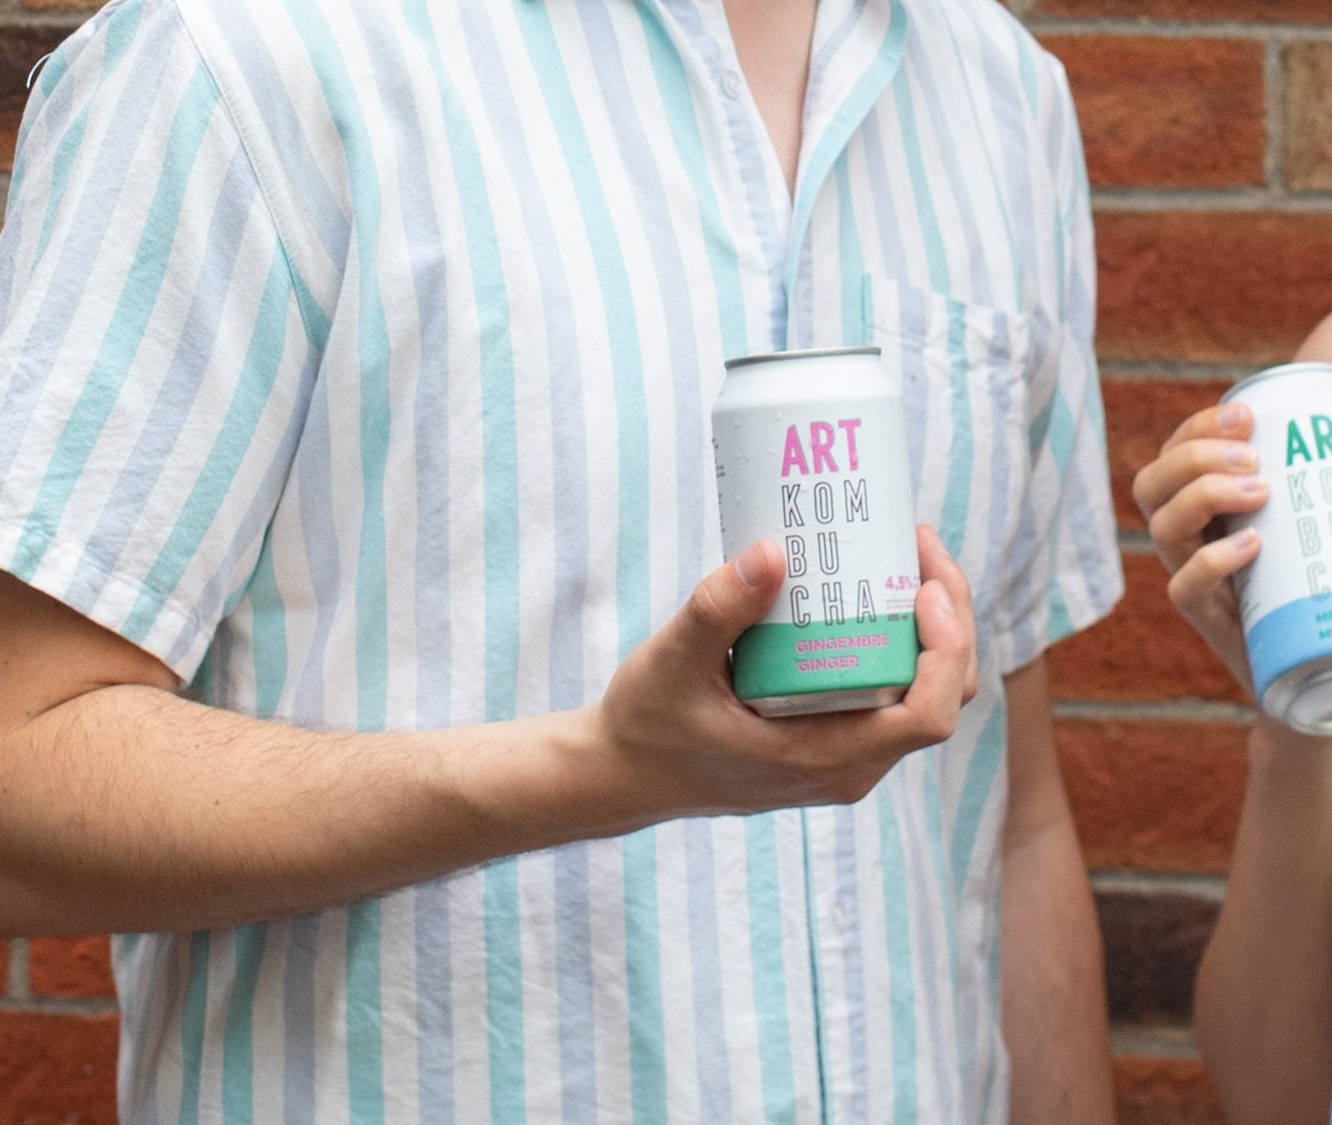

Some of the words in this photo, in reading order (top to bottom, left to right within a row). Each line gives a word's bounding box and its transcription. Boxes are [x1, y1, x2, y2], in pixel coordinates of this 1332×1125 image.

[781, 419, 862, 477] ART
[781, 479, 870, 527] KOM
[785, 531, 840, 578] BU
[790, 579, 876, 628] CHA
[795, 634, 889, 654] GINGEMBRE
[797, 656, 859, 673] GINGER
